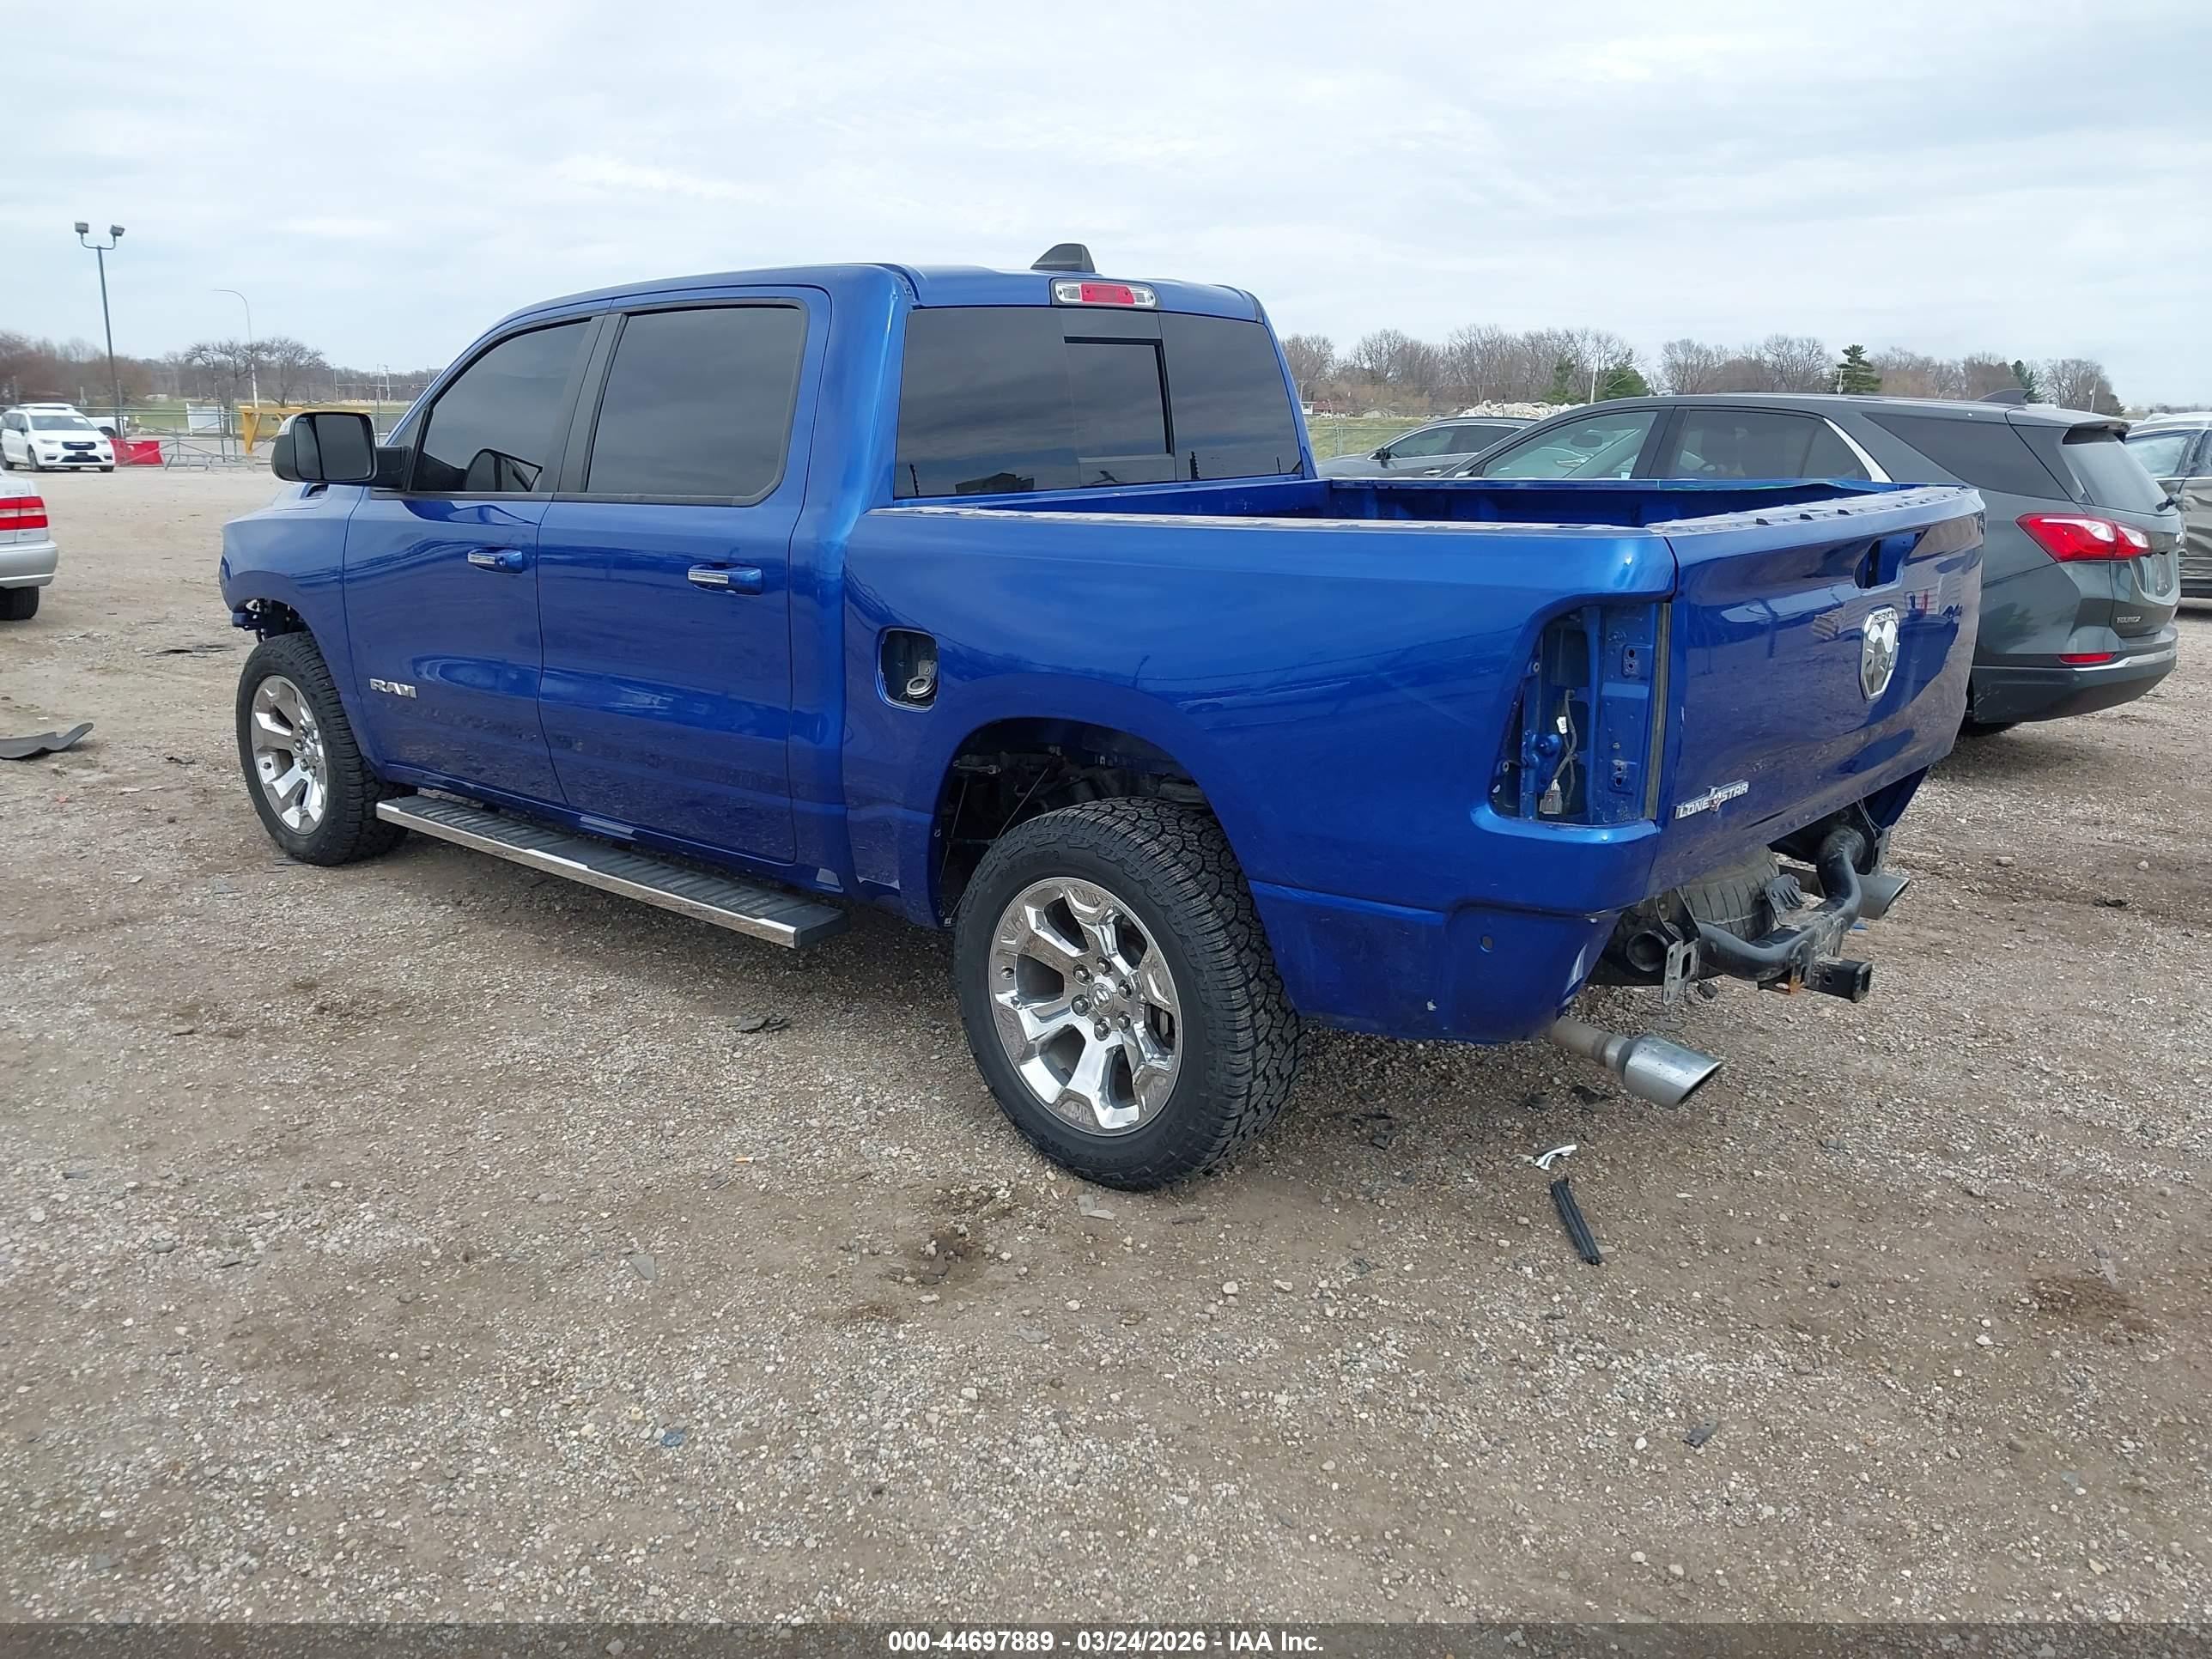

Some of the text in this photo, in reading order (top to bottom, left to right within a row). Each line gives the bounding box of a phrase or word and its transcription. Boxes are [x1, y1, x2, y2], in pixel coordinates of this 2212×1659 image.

[369, 678, 417, 700] RAM
[1679, 782, 1749, 818] LONE STAR
